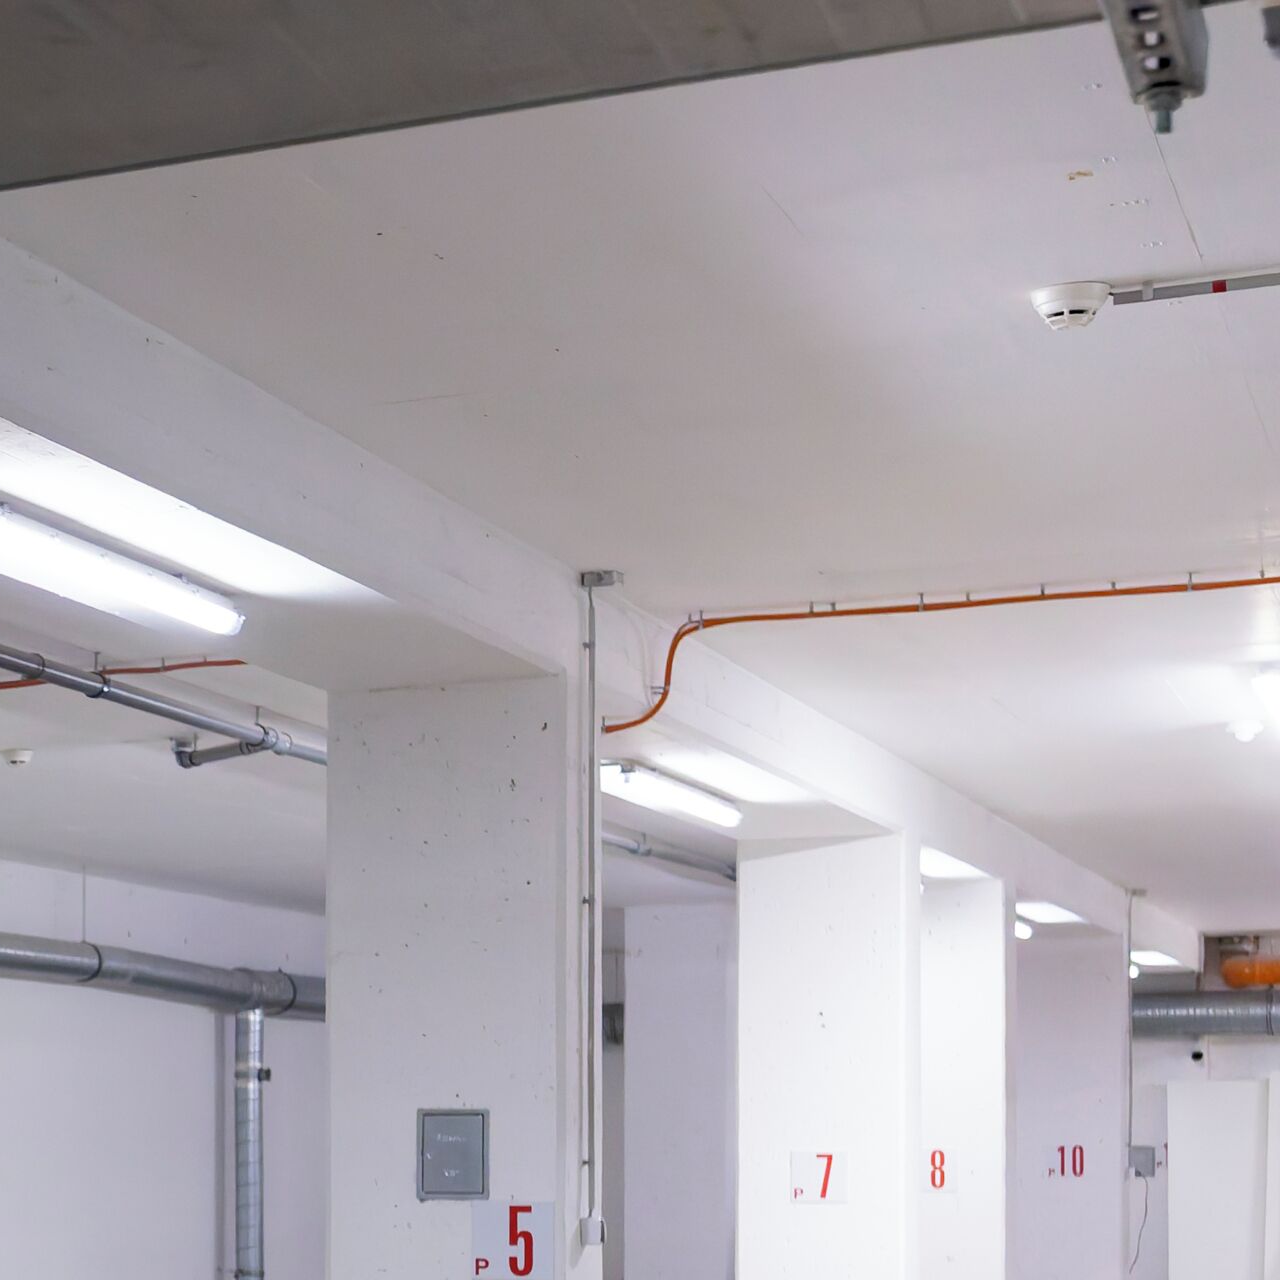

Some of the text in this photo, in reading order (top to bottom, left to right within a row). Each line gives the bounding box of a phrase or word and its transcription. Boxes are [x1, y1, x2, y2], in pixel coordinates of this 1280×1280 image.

[816, 1154, 832, 1198] 7
[930, 1150, 945, 1188] 8
[1058, 1145, 1084, 1177] 10
[475, 1205, 533, 1276] P 5
